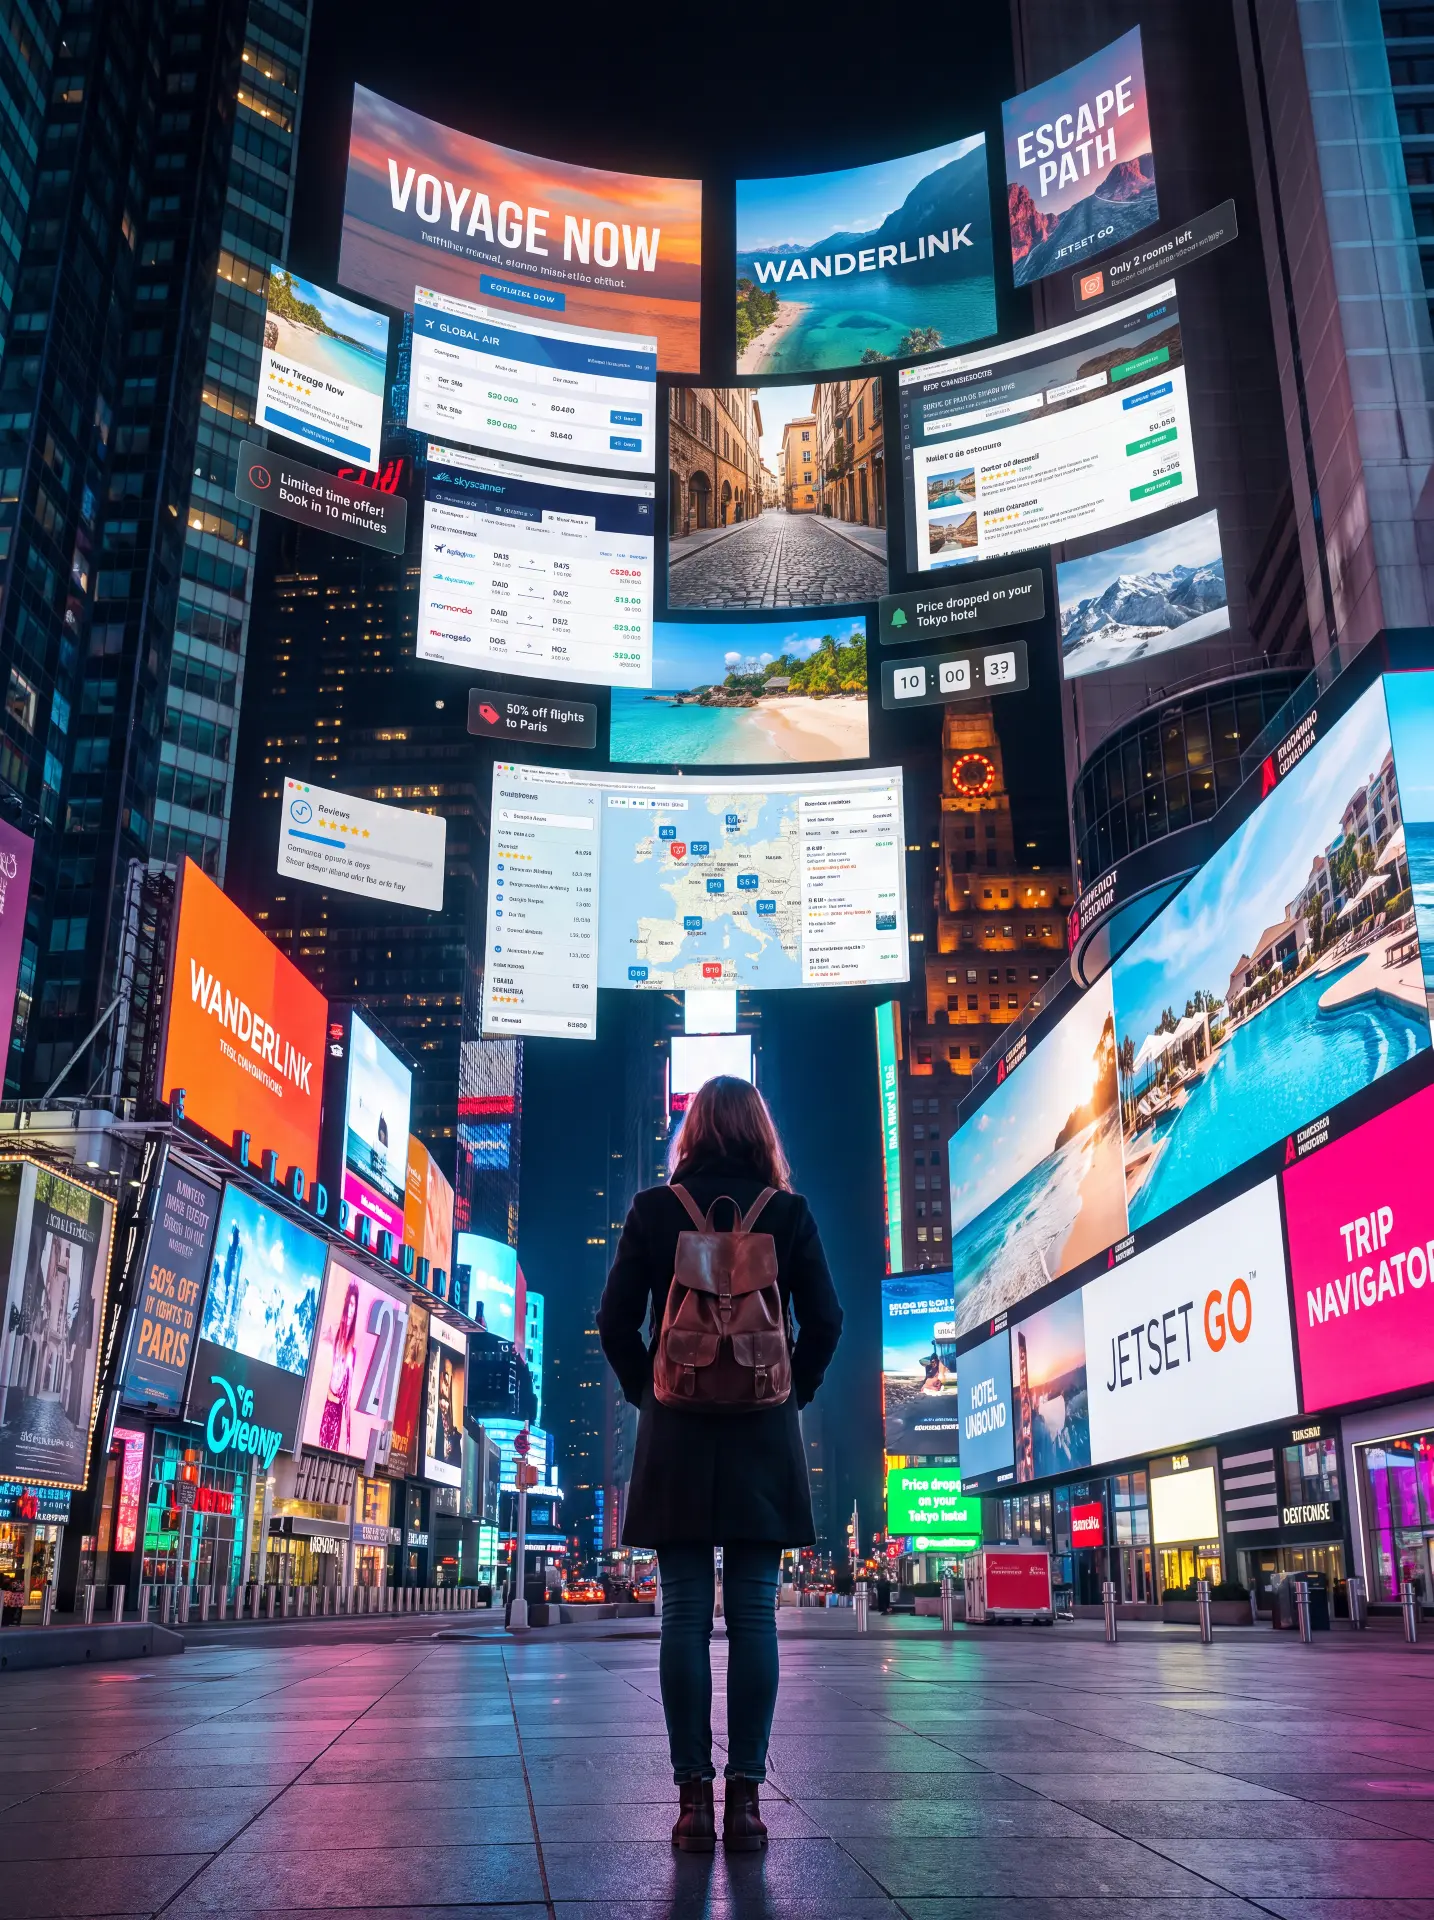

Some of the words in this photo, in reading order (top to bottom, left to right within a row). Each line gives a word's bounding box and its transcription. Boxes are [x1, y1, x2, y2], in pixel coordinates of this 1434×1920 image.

[1017, 75, 1135, 169] ESCAPE
[1039, 126, 1117, 197] PATH
[388, 158, 550, 257] VOYAGE
[564, 215, 661, 272] NOW
[1098, 225, 1114, 239] GO
[753, 223, 974, 285] WANDERLINK
[1109, 260, 1131, 277] Only
[1133, 256, 1140, 267] 2
[1142, 242, 1173, 263] rooms
[1175, 230, 1193, 247] left
[439, 323, 480, 343] GLOBAL
[482, 334, 500, 346] AIR
[279, 488, 308, 511] Book
[311, 498, 322, 513] in
[325, 503, 339, 519] 10
[341, 508, 387, 534] minutes
[280, 472, 323, 500] Limited
[325, 489, 350, 508] time
[353, 496, 385, 518] offer!
[916, 601, 944, 614] Price
[946, 591, 990, 609] dropped
[992, 590, 1006, 600] on
[1008, 584, 1033, 599] your
[917, 613, 948, 627] Tokyo
[950, 607, 978, 621] hotel
[900, 675, 920, 690] 10
[945, 669, 965, 683] 00
[506, 703, 529, 716] 50%
[532, 707, 548, 718] off
[550, 709, 585, 723] flights
[506, 718, 517, 728] to
[520, 719, 548, 732] Paris
[318, 804, 351, 820] Reviews
[190, 957, 313, 1096] WANDERLINK
[1340, 1205, 1394, 1263] TRIP
[149, 1264, 177, 1299] 50%
[177, 1277, 200, 1307] OFF
[137, 1318, 189, 1368] PARIS
[1107, 1301, 1193, 1392] JETSET
[1204, 1278, 1252, 1353] GO
[971, 1378, 998, 1410] HOTEL
[965, 1403, 1006, 1440] UNBOUND
[902, 1479, 929, 1491] Price
[918, 1496, 932, 1506] on
[933, 1496, 957, 1508] your
[908, 1510, 939, 1524] Tokyo
[941, 1509, 967, 1521] hotel
